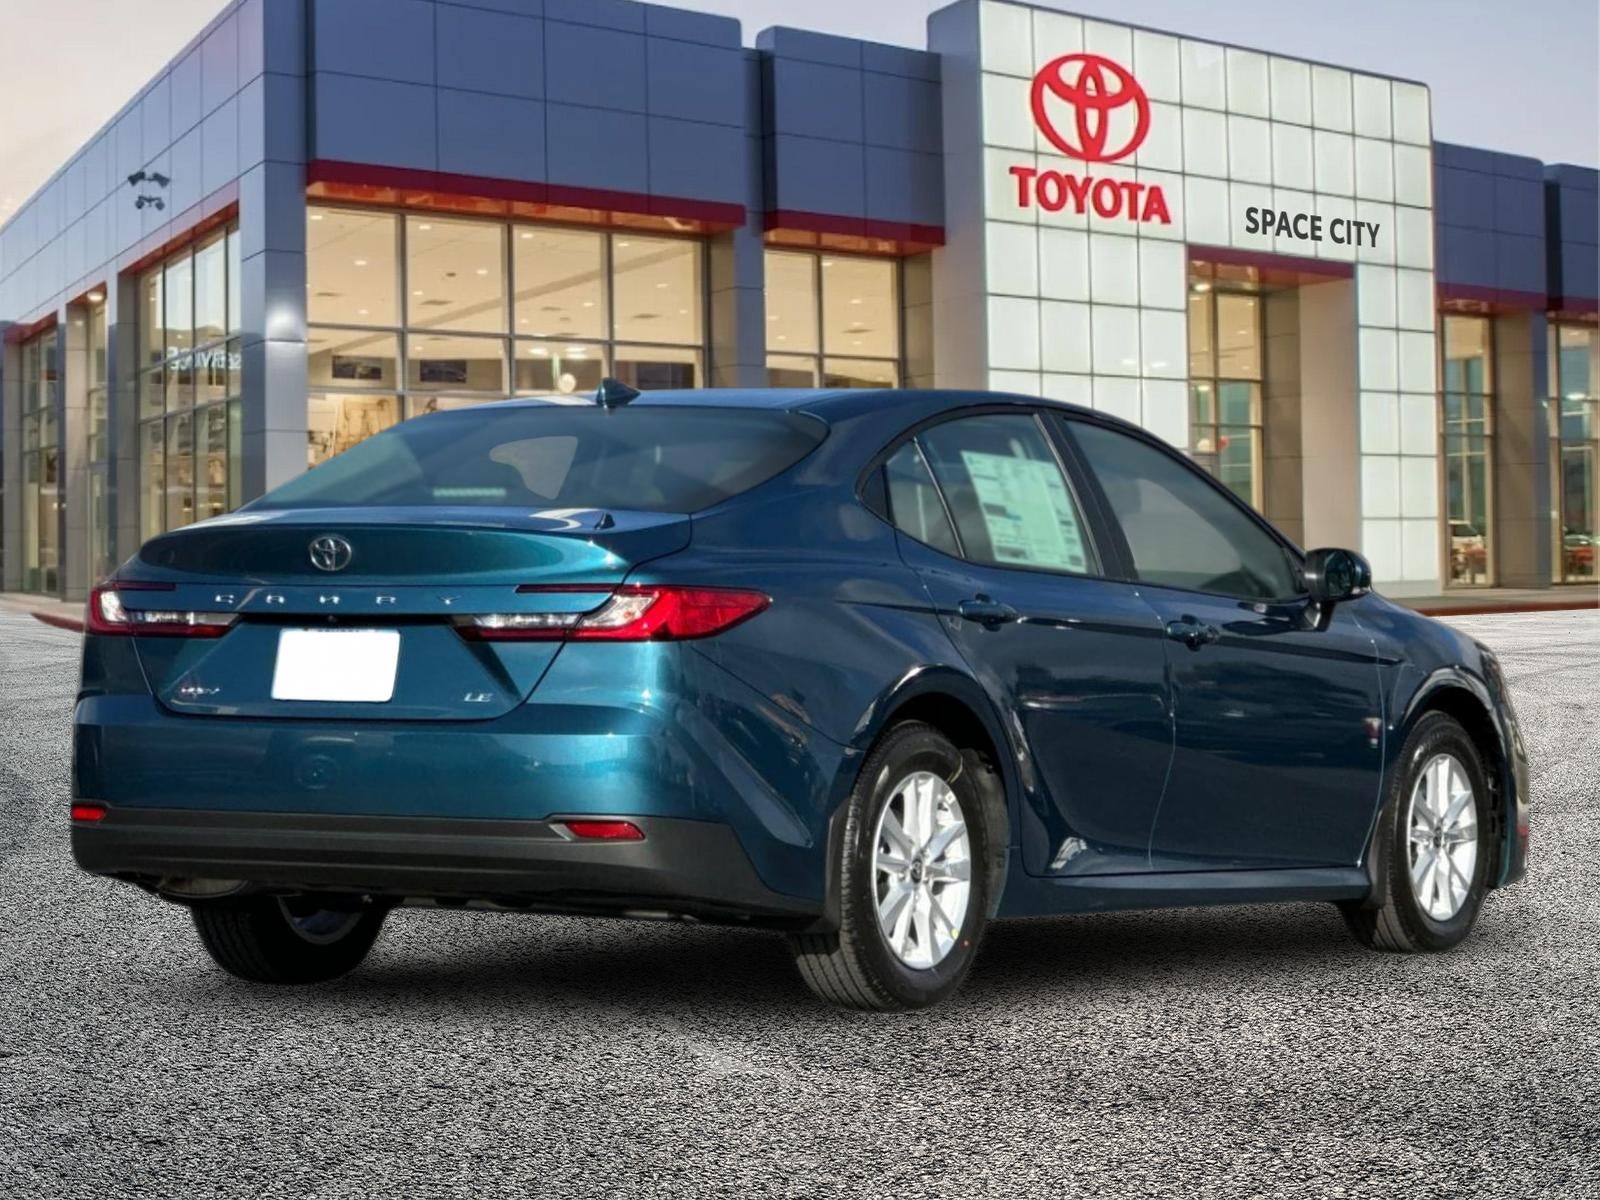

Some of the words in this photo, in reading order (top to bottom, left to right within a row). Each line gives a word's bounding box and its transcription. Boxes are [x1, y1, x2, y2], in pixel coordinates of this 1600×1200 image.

[1009, 166, 1171, 224] TOYOTA
[1245, 206, 1322, 241] SPACE
[1330, 217, 1381, 248] CITY
[463, 692, 494, 702] LE
